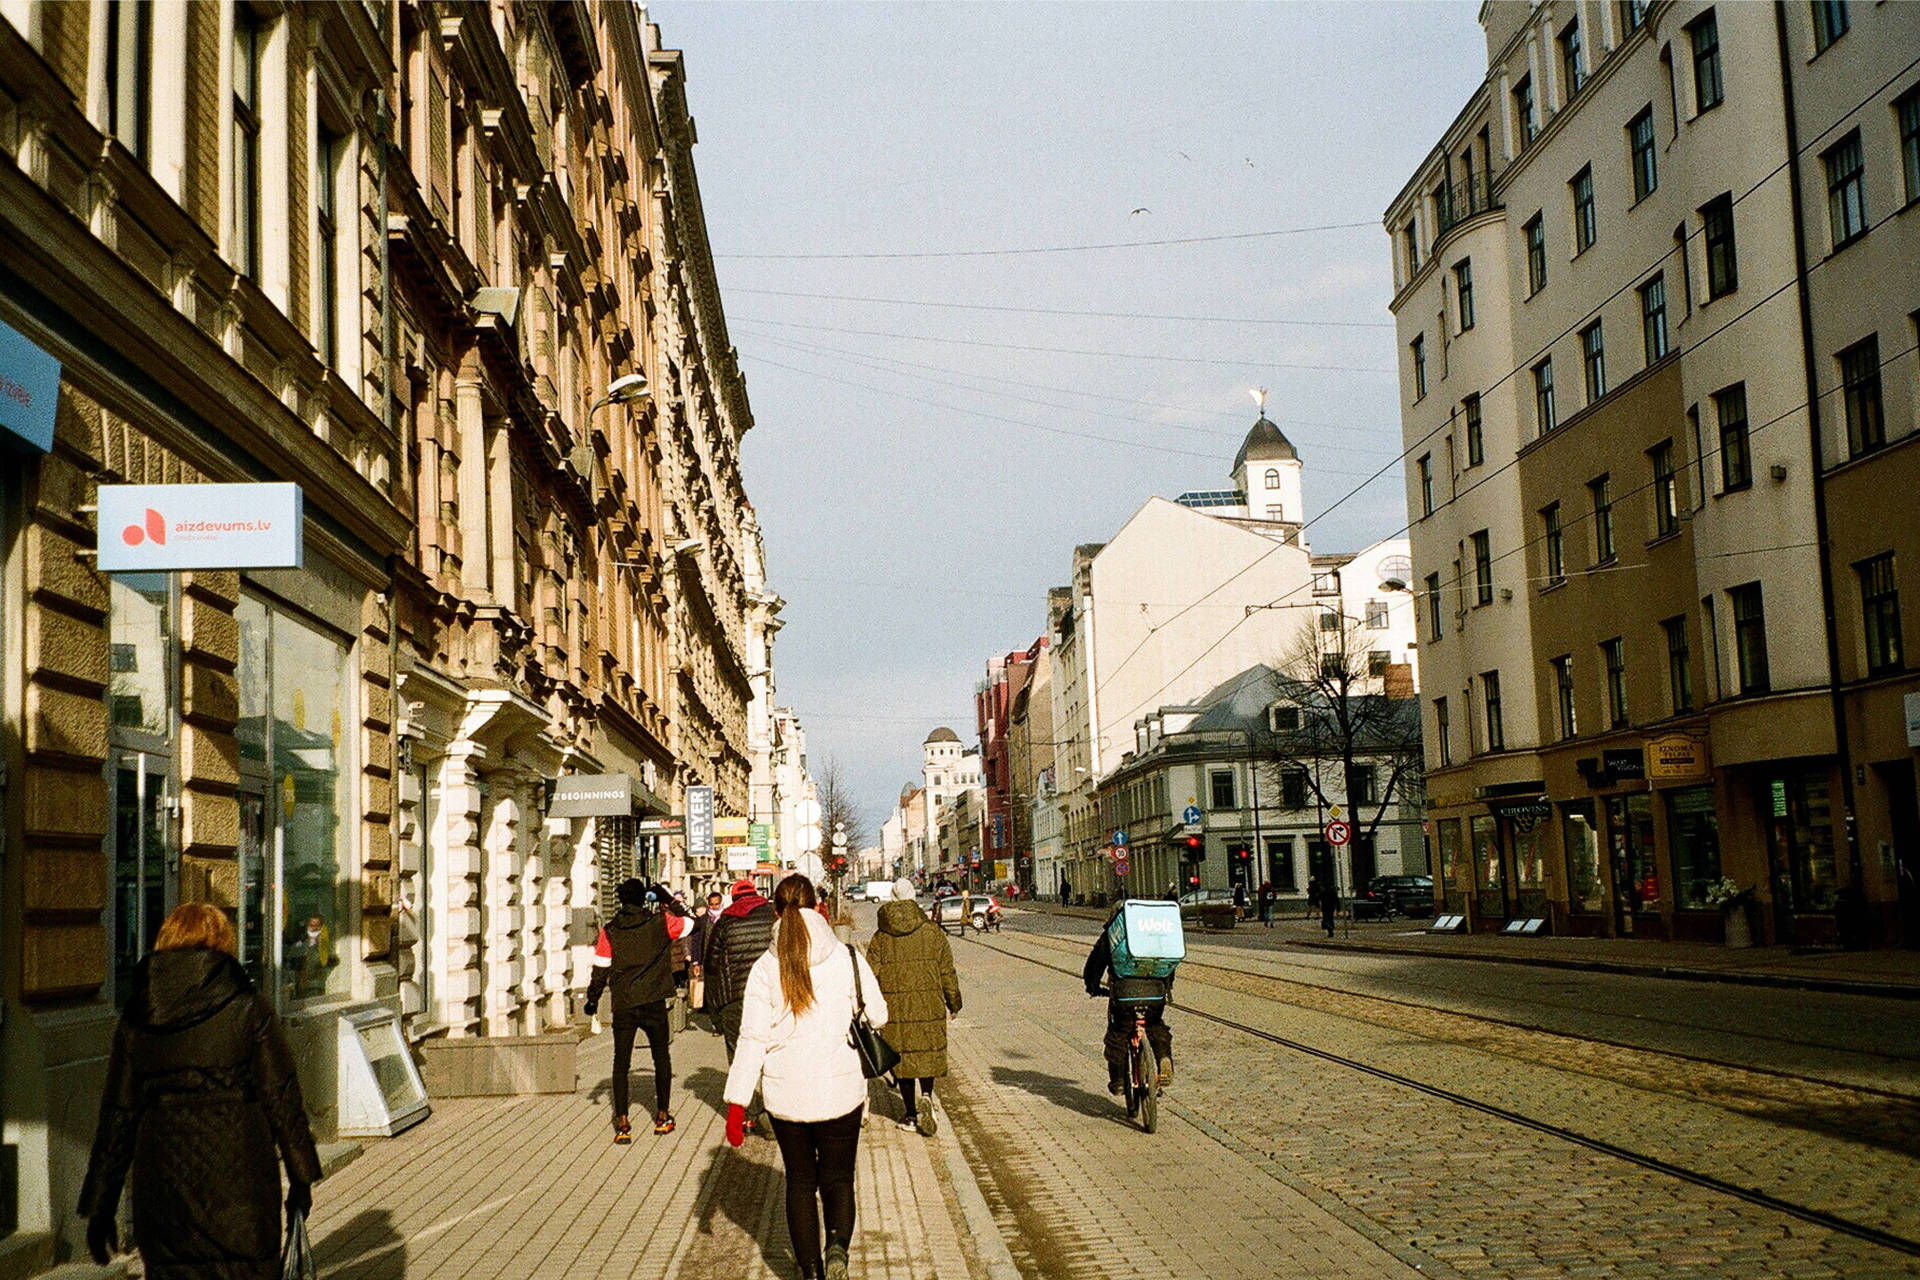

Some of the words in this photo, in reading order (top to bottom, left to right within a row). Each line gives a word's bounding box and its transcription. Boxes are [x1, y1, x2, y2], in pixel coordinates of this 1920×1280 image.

[175, 519, 272, 532] aizdevums.lv
[690, 791, 705, 851] MEYER
[1137, 917, 1174, 932] Wolt
